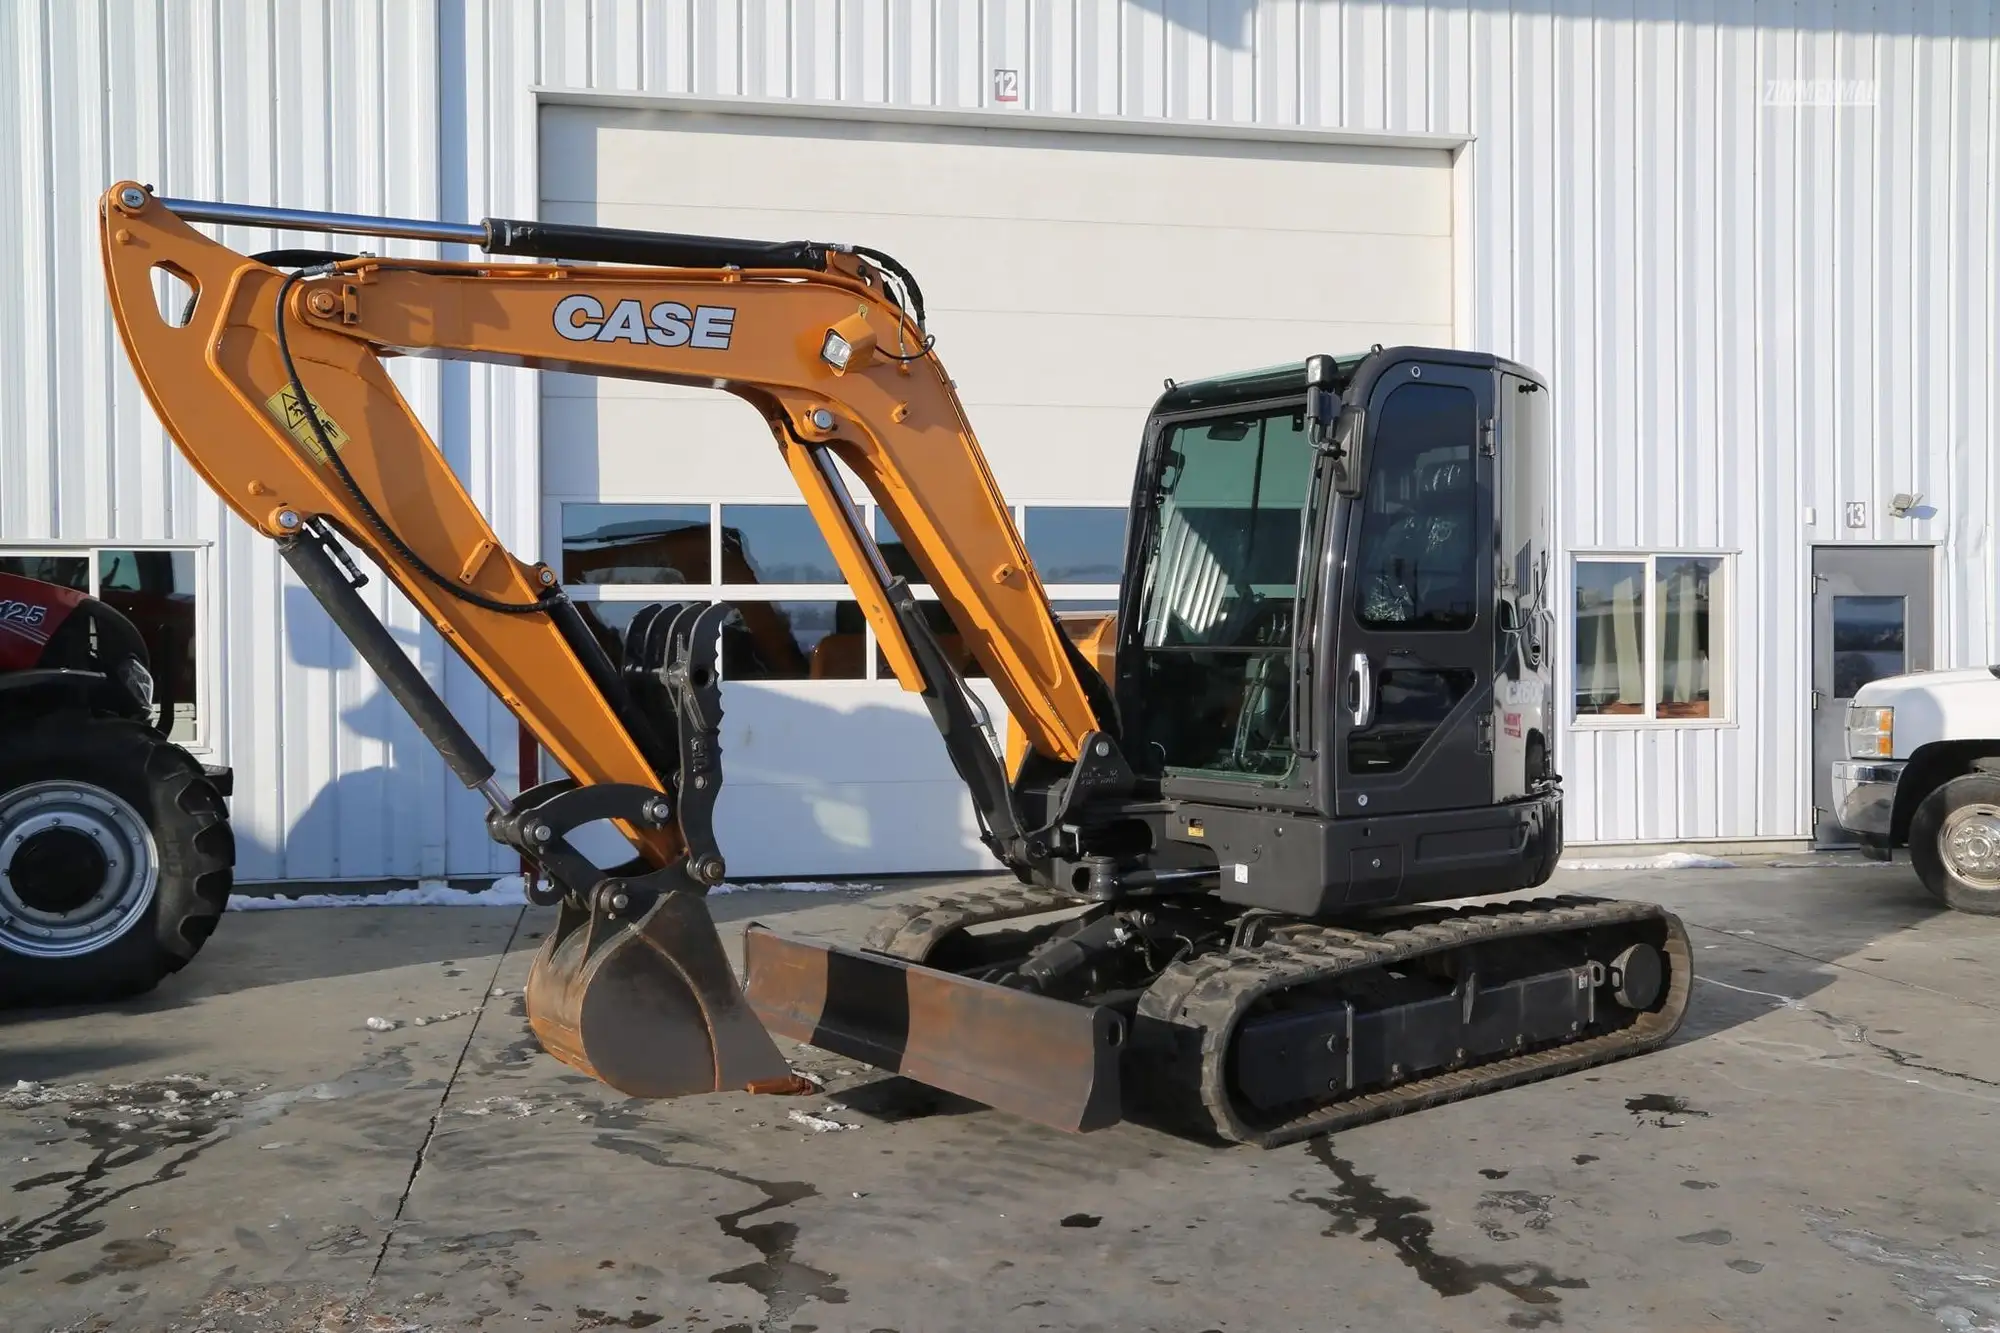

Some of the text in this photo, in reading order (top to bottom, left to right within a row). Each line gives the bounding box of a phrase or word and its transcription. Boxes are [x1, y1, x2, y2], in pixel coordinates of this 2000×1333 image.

[995, 71, 1017, 97] 12
[553, 294, 736, 350] CASE
[1846, 503, 1865, 526] 13
